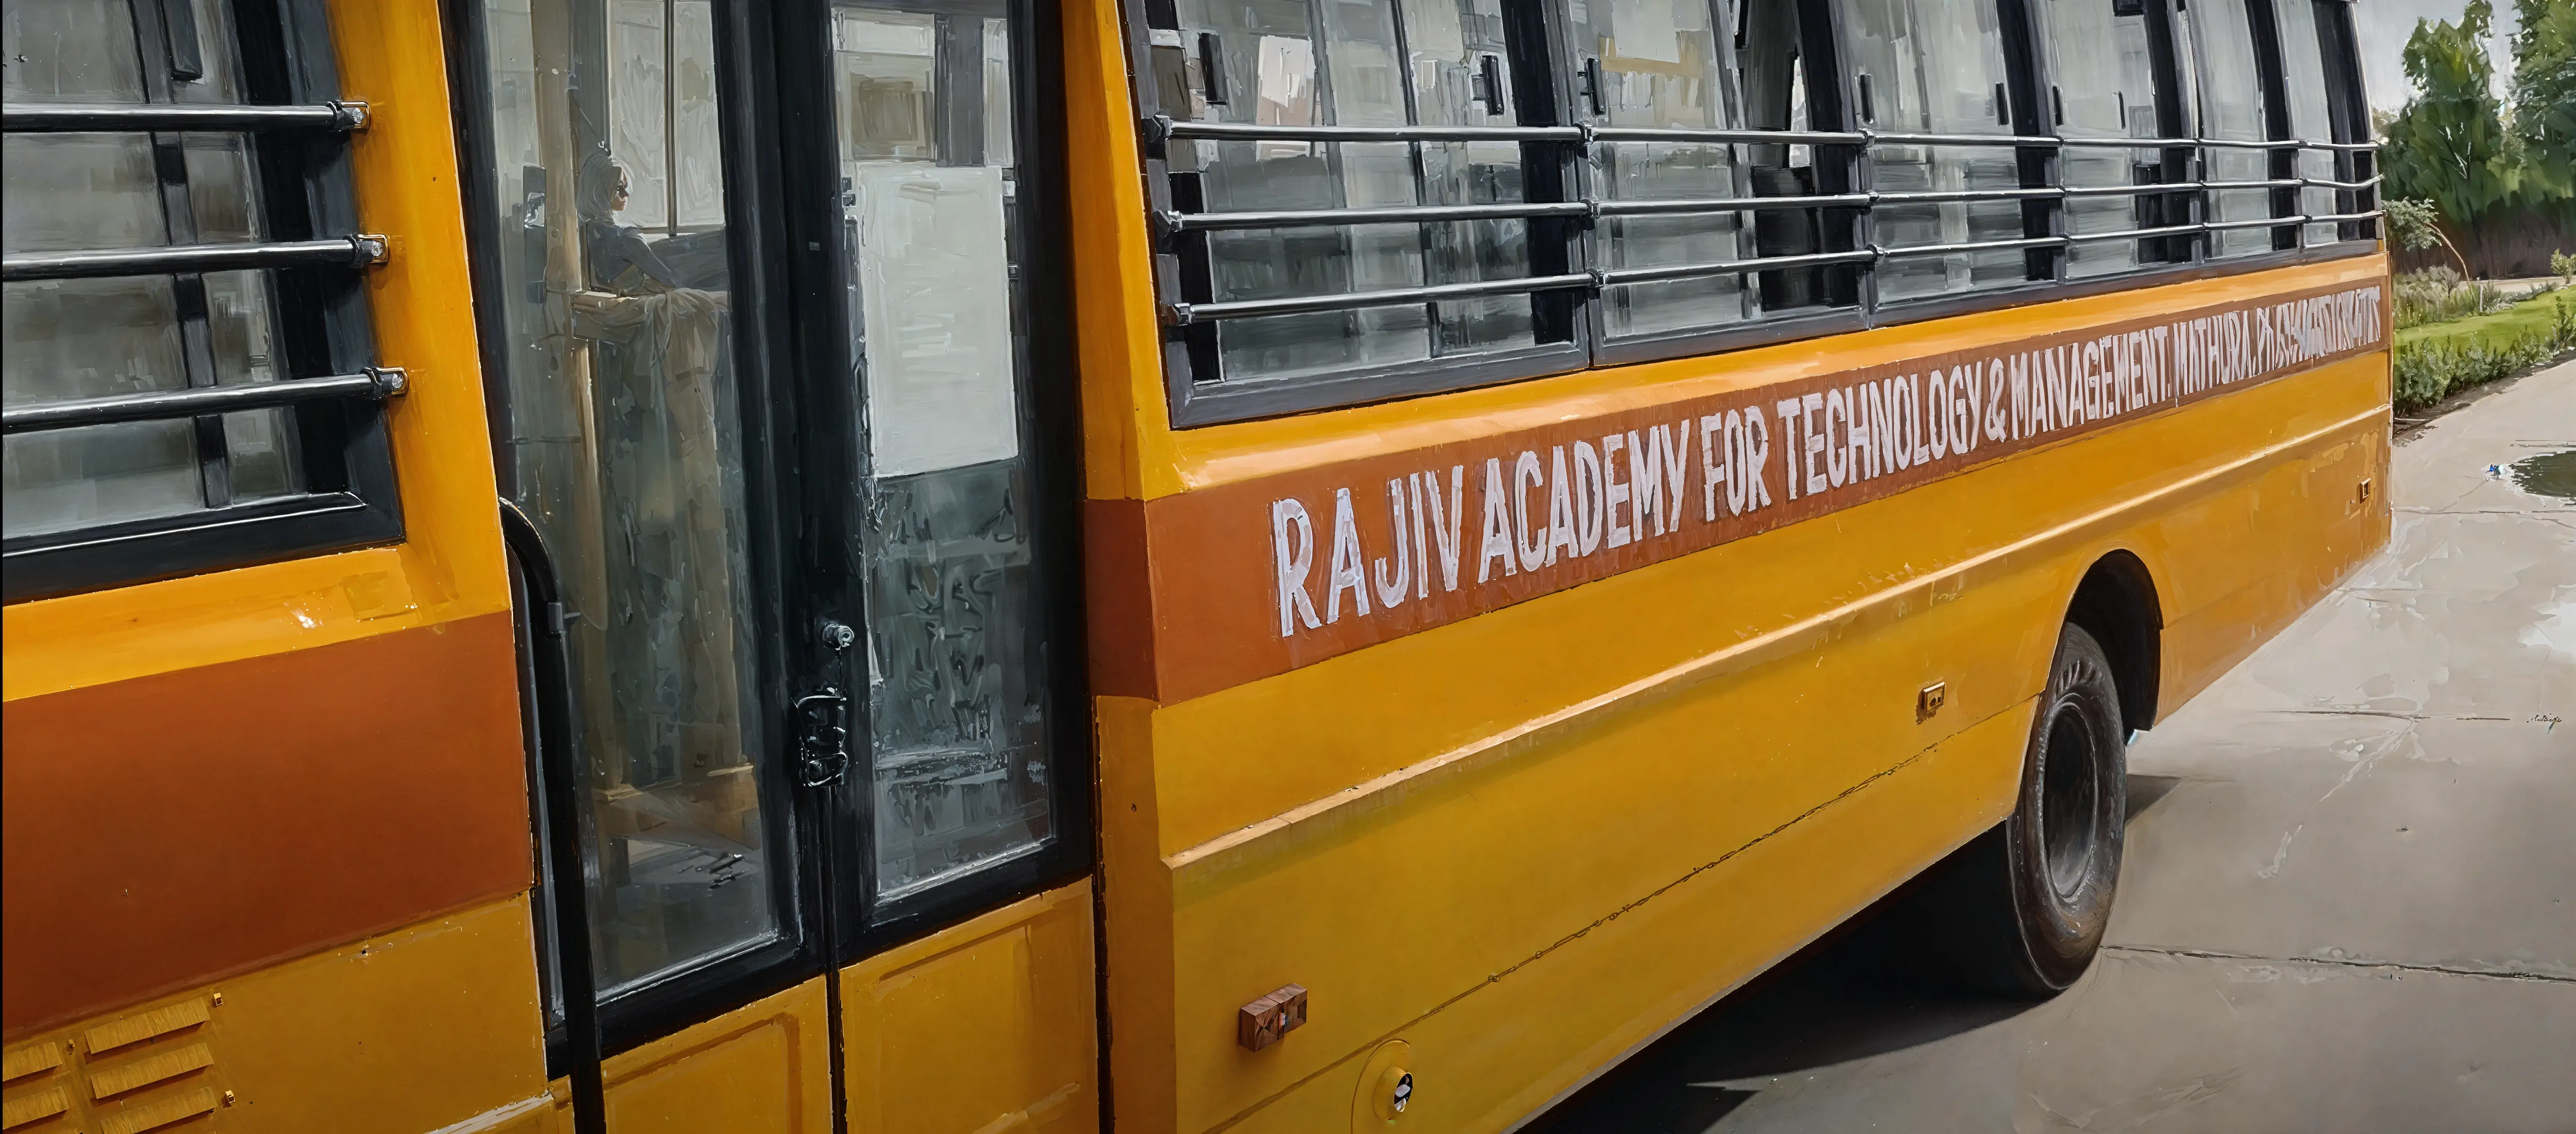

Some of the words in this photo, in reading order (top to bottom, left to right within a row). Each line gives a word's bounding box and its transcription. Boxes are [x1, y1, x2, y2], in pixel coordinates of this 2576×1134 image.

[1273, 465, 1463, 637] RAJIV
[1478, 419, 1690, 583] ACADEMY
[1701, 406, 1771, 522] FOR
[1777, 361, 1982, 500] TECHNOLOGY
[1984, 357, 2007, 442] &
